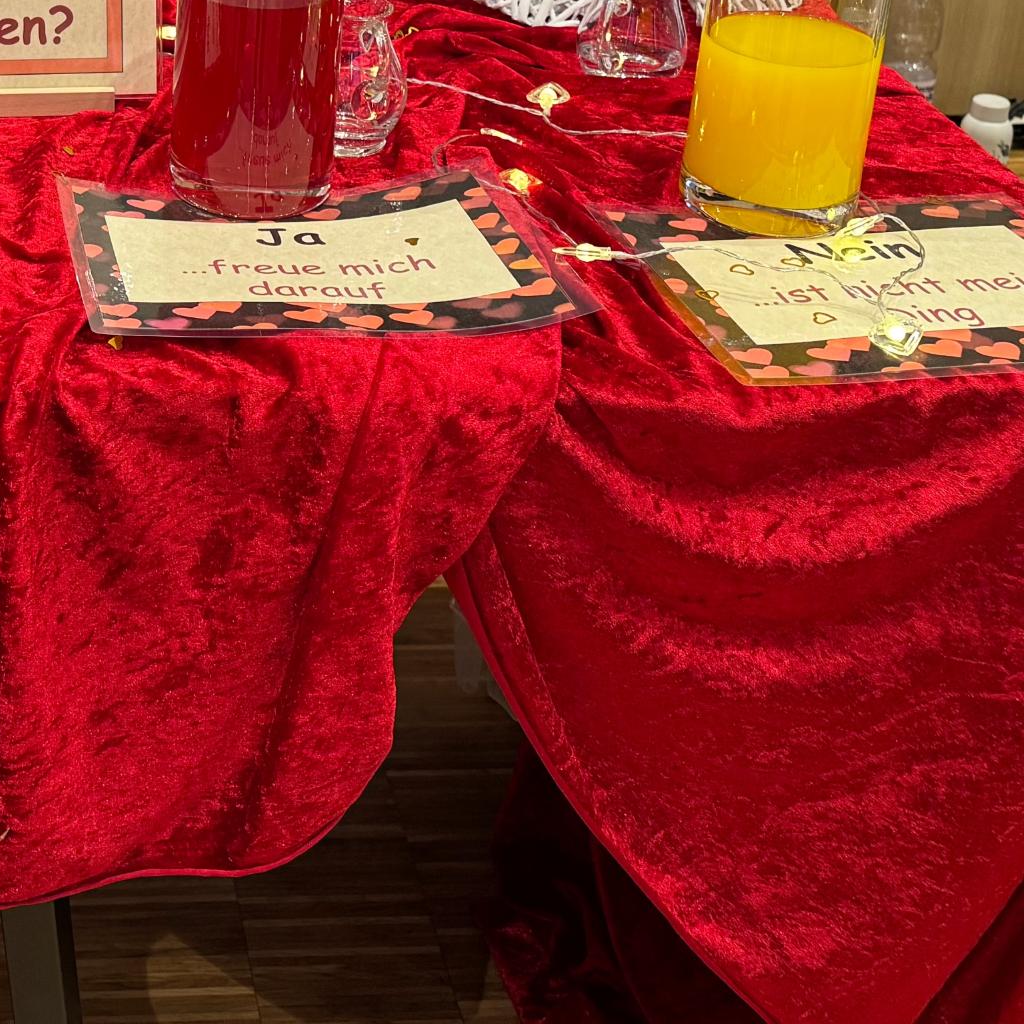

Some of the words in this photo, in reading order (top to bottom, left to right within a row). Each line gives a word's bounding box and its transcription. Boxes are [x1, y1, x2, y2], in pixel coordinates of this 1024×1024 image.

[256, 228, 326, 247] Ja
[182, 259, 326, 275] ...freue
[339, 254, 437, 276] mich
[249, 280, 387, 299] darauf
[754, 284, 830, 308] ...ist
